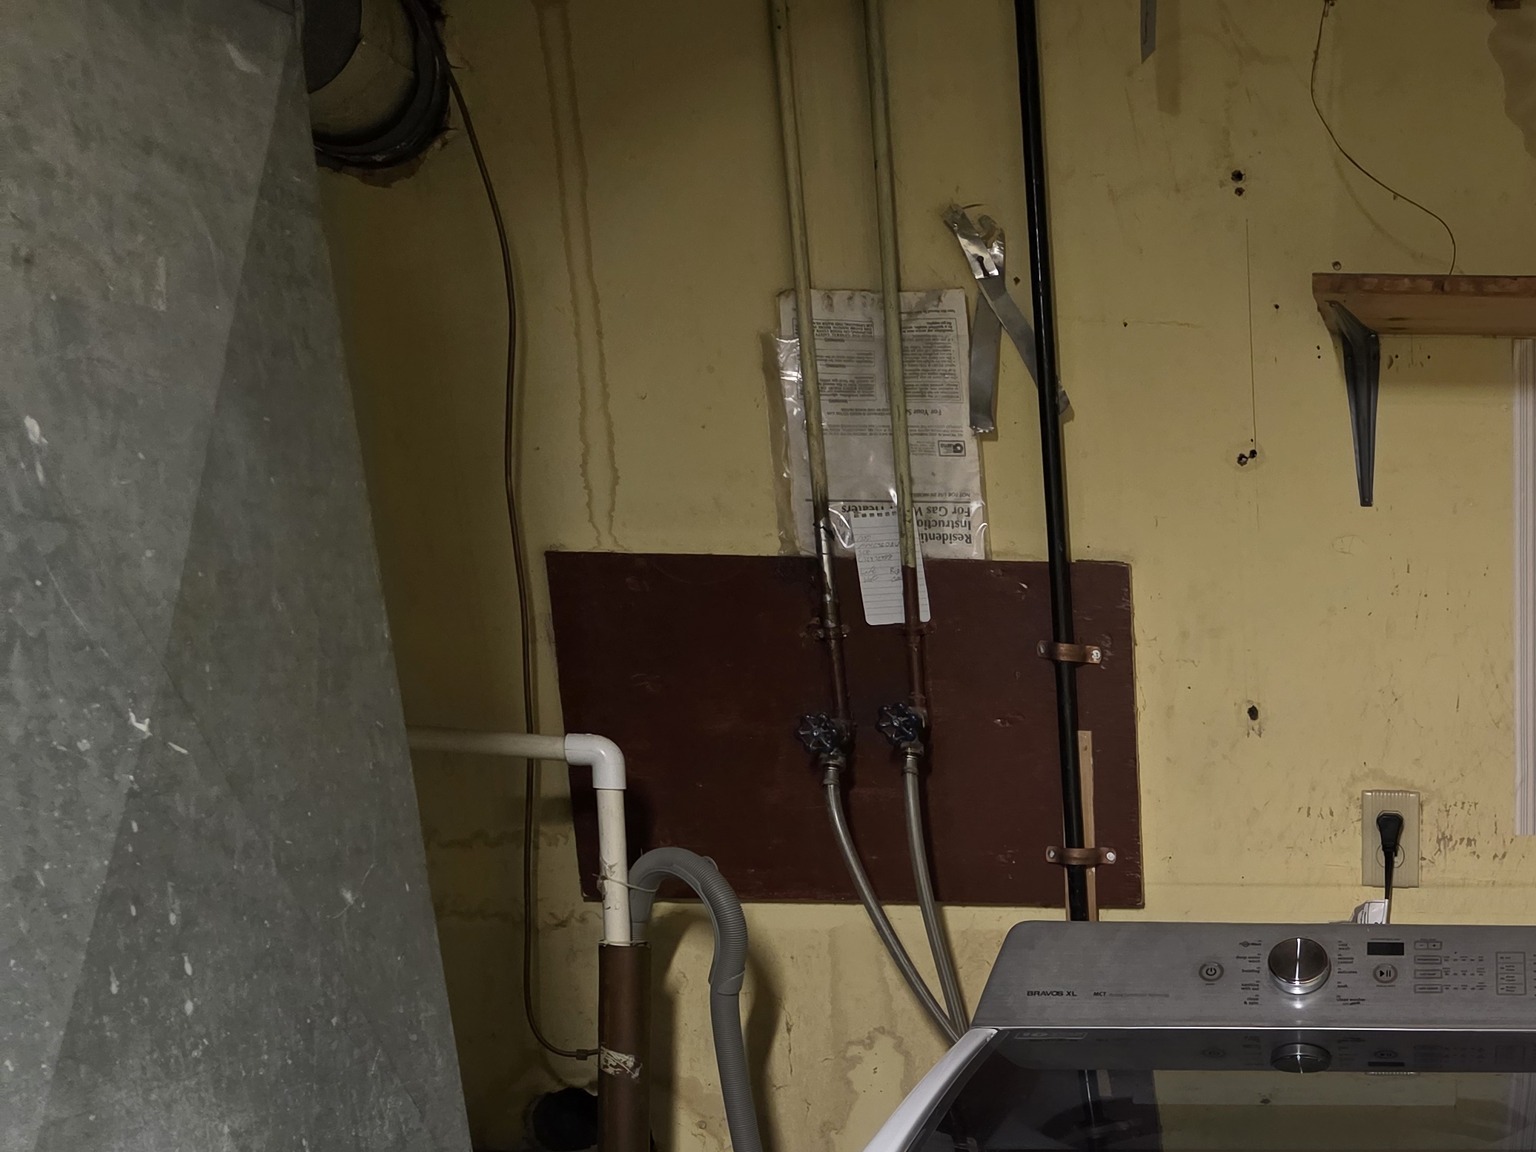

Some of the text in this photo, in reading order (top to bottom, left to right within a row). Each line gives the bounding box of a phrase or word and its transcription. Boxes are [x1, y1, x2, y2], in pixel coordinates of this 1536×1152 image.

[926, 506, 948, 517] Gas
[952, 506, 970, 517] For
[916, 520, 971, 530] Instructio
[920, 533, 972, 544] Residenti
